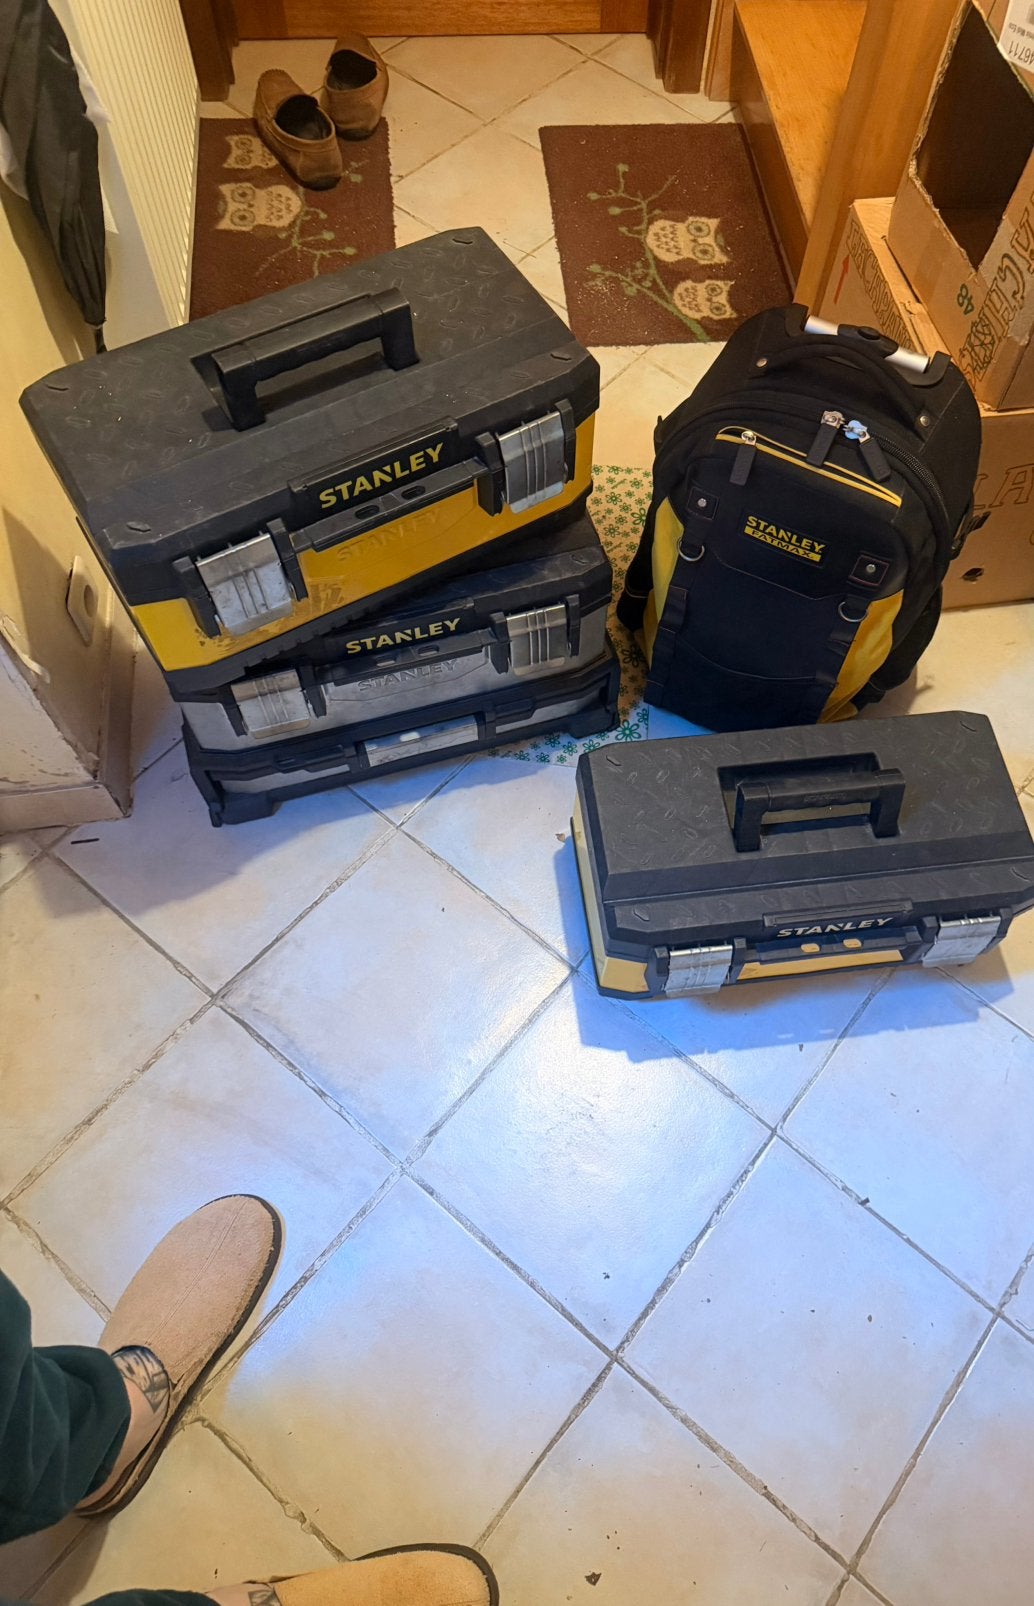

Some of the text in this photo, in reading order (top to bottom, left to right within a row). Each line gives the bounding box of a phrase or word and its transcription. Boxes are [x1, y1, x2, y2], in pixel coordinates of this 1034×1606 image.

[319, 442, 444, 509] STANLEY
[746, 516, 825, 553] STANLEY
[751, 529, 813, 558] FATMAX
[345, 618, 461, 654] STANLEY
[357, 659, 458, 691] STANLEY
[776, 917, 893, 938] STANLEY
